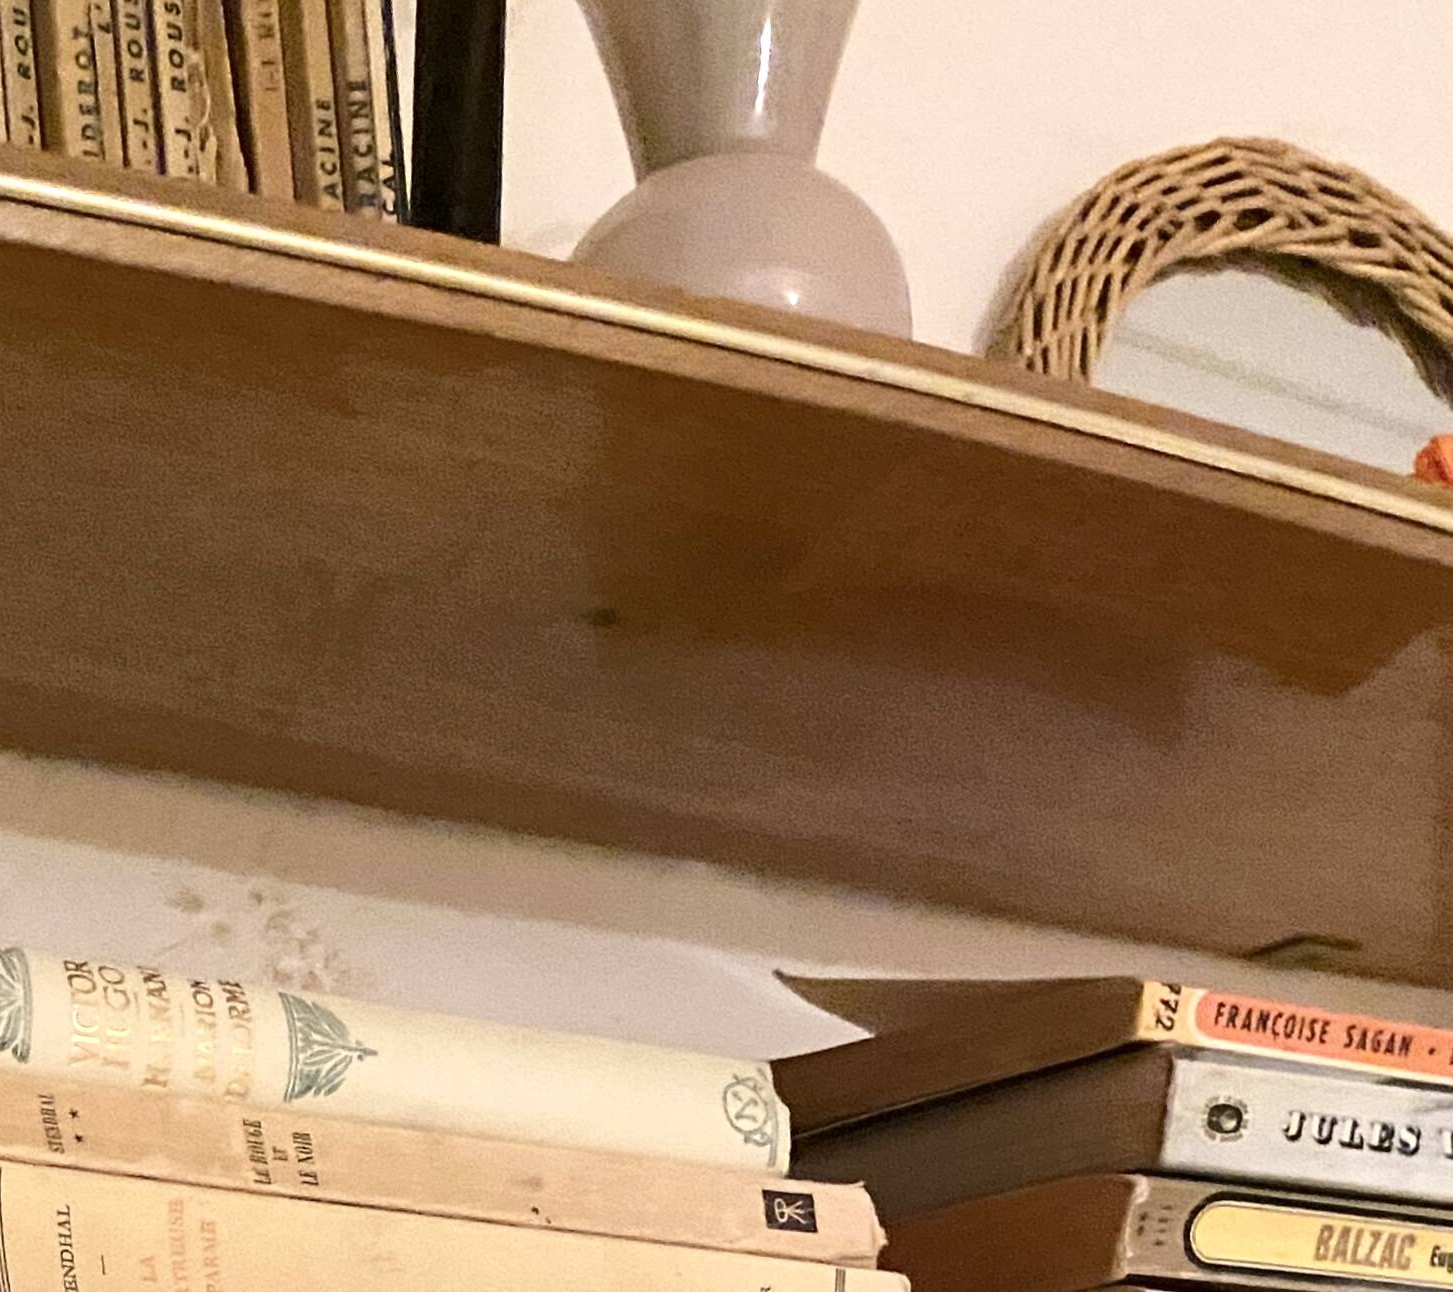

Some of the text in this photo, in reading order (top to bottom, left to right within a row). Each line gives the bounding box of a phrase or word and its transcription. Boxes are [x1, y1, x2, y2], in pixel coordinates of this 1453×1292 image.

[316, 98, 340, 200] ACINE
[1214, 1001, 1414, 1058] FRANÇOISE SAGAN
[293, 1131, 319, 1186] LE NOIR
[1282, 1109, 1422, 1157] JULES
[1313, 1224, 1417, 1271] BALZAC
